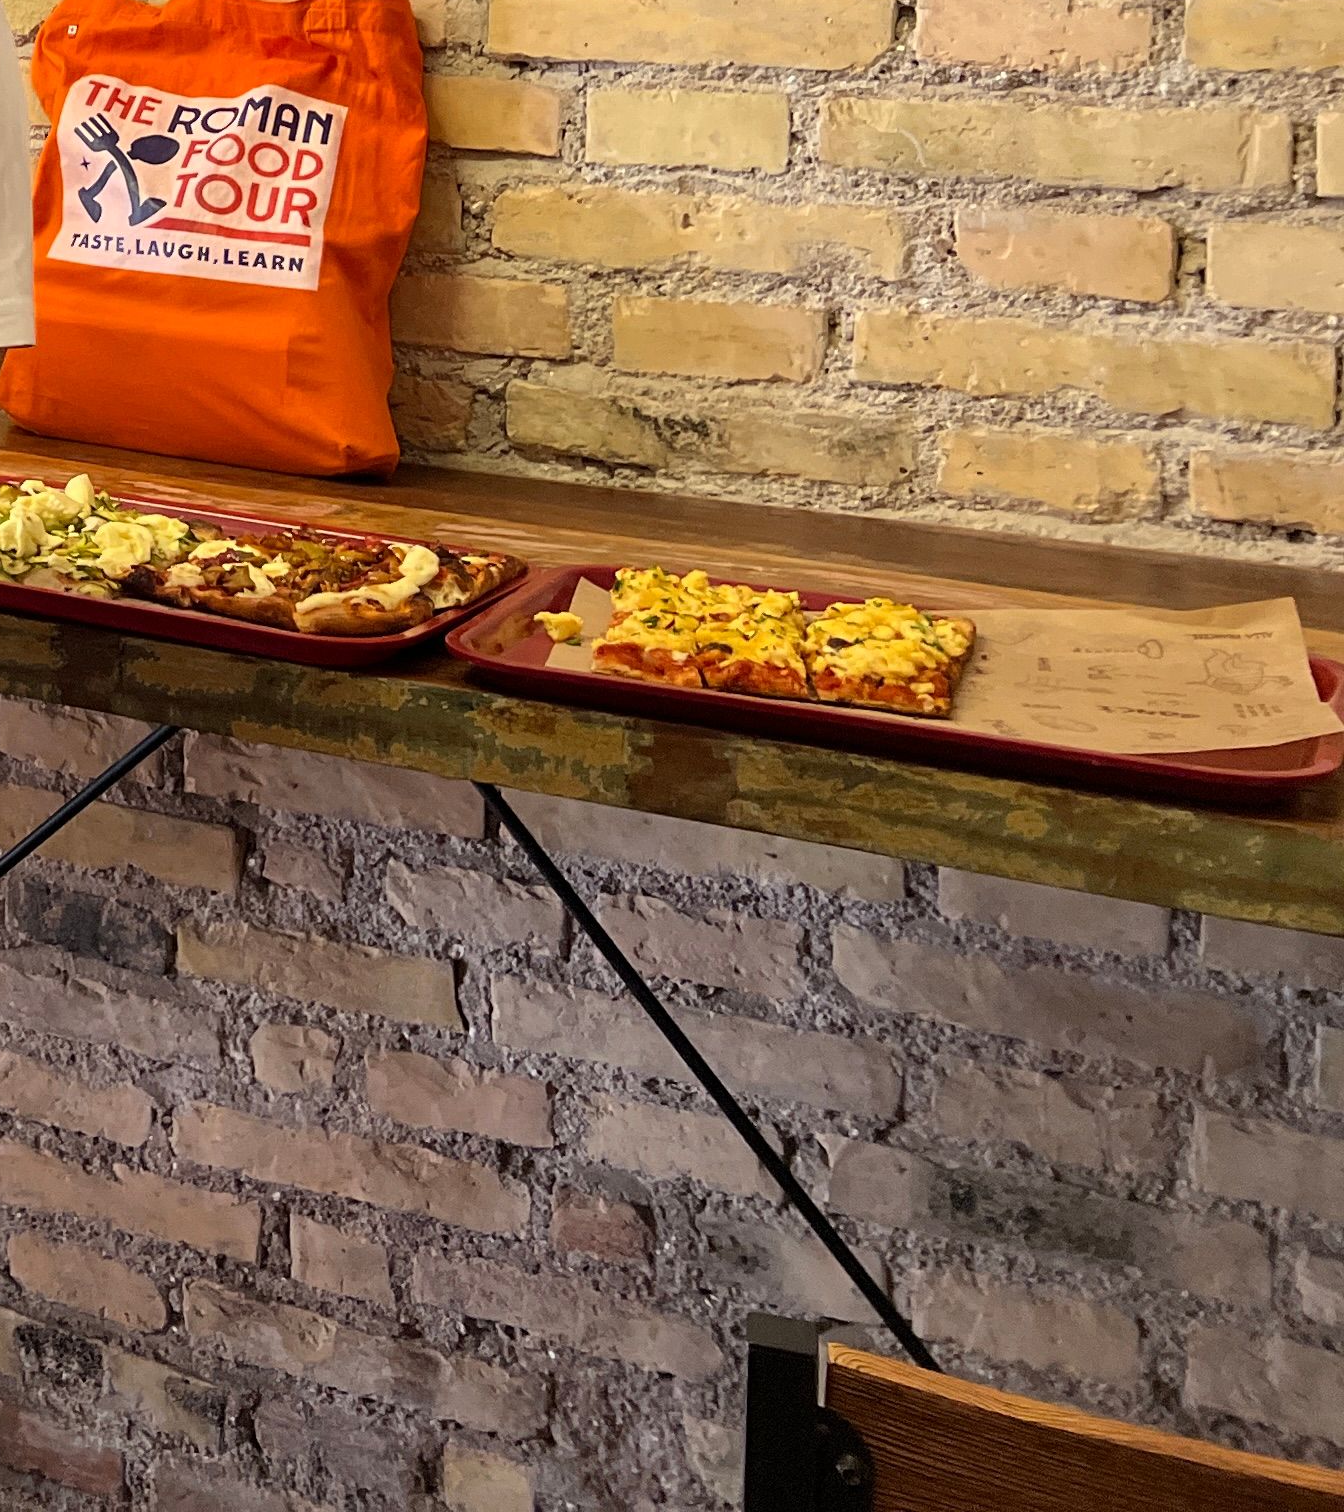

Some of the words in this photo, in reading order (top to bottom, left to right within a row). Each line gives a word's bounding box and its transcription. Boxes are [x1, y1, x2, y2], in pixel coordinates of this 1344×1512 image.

[85, 80, 162, 126] THE
[168, 95, 333, 145] ROMAN
[181, 133, 323, 181] FOOD
[174, 172, 318, 228] TOUR
[223, 248, 306, 274] LEARN
